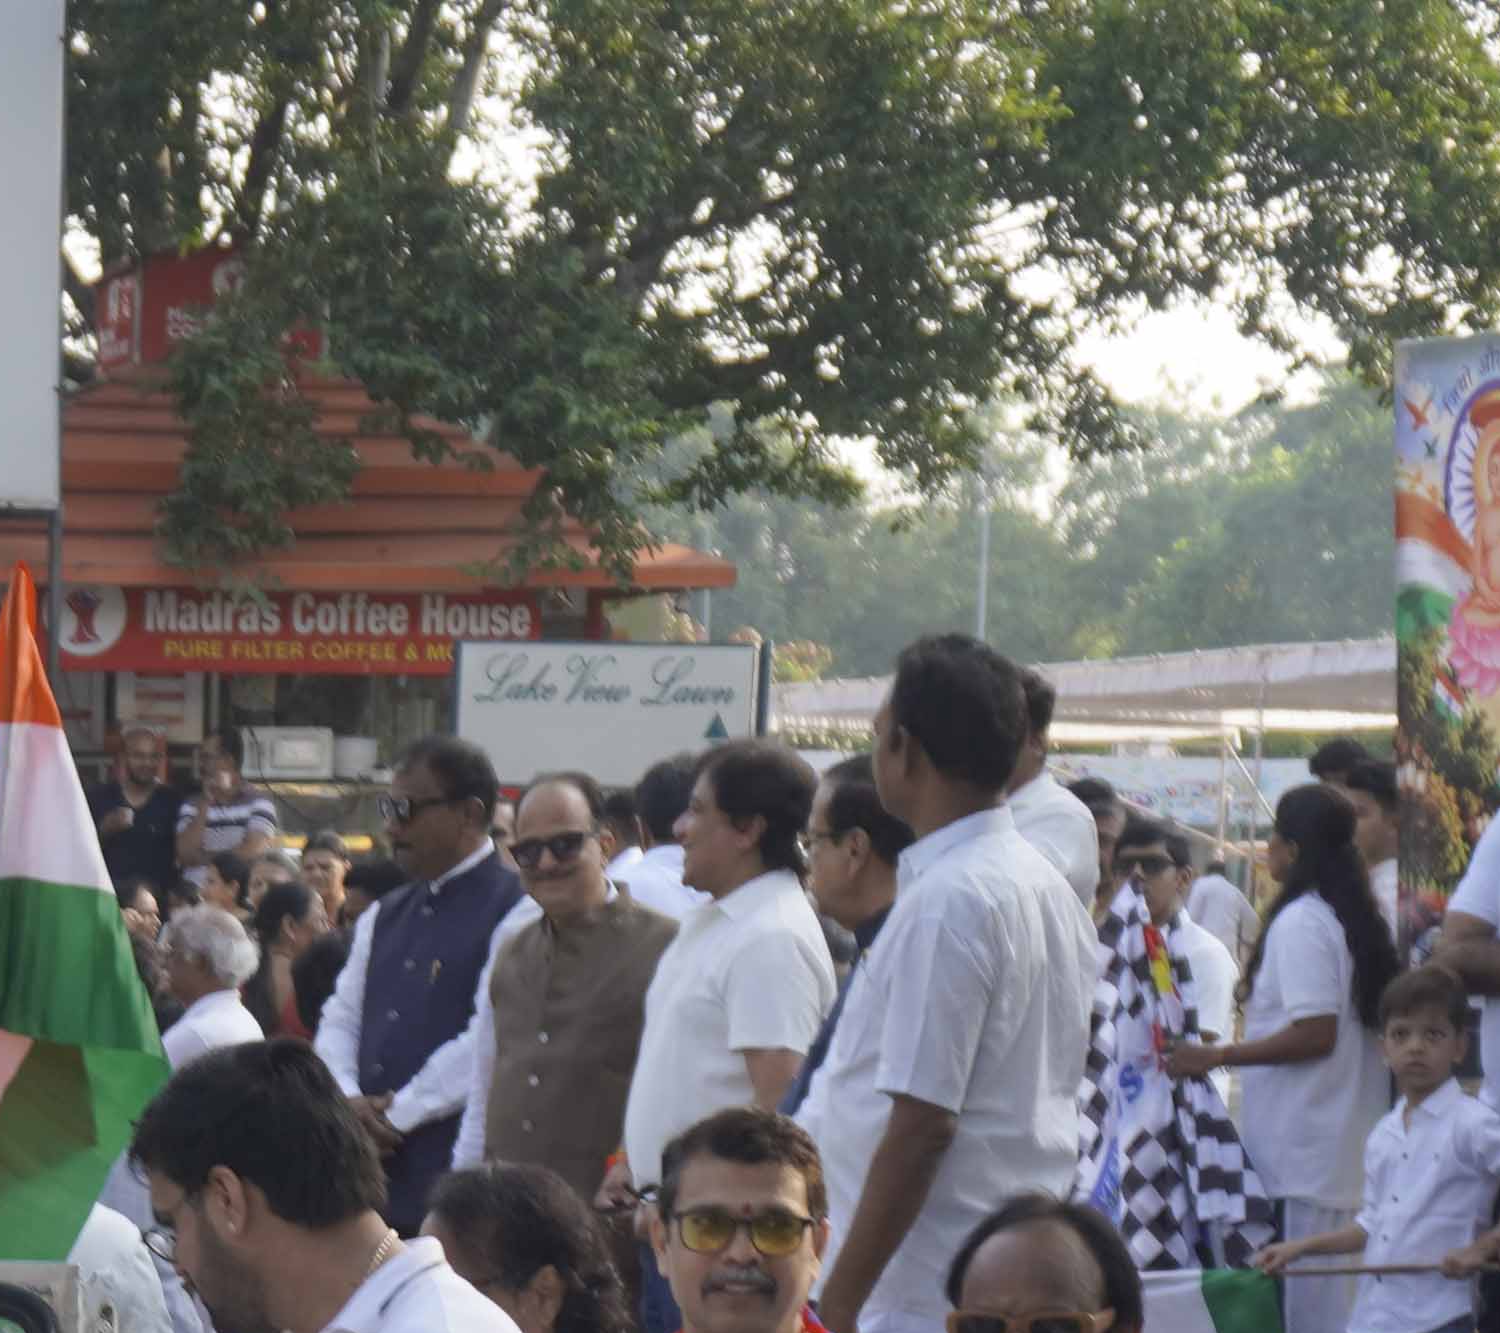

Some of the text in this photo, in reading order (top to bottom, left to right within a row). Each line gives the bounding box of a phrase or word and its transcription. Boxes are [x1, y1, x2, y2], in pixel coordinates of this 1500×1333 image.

[144, 590, 531, 637] Madras Coffee House
[163, 638, 223, 660] PURE
[230, 639, 302, 661] FILTER
[310, 640, 397, 662] COFFEE
[404, 641, 419, 661] &
[474, 652, 735, 707] Lake View Lawn
